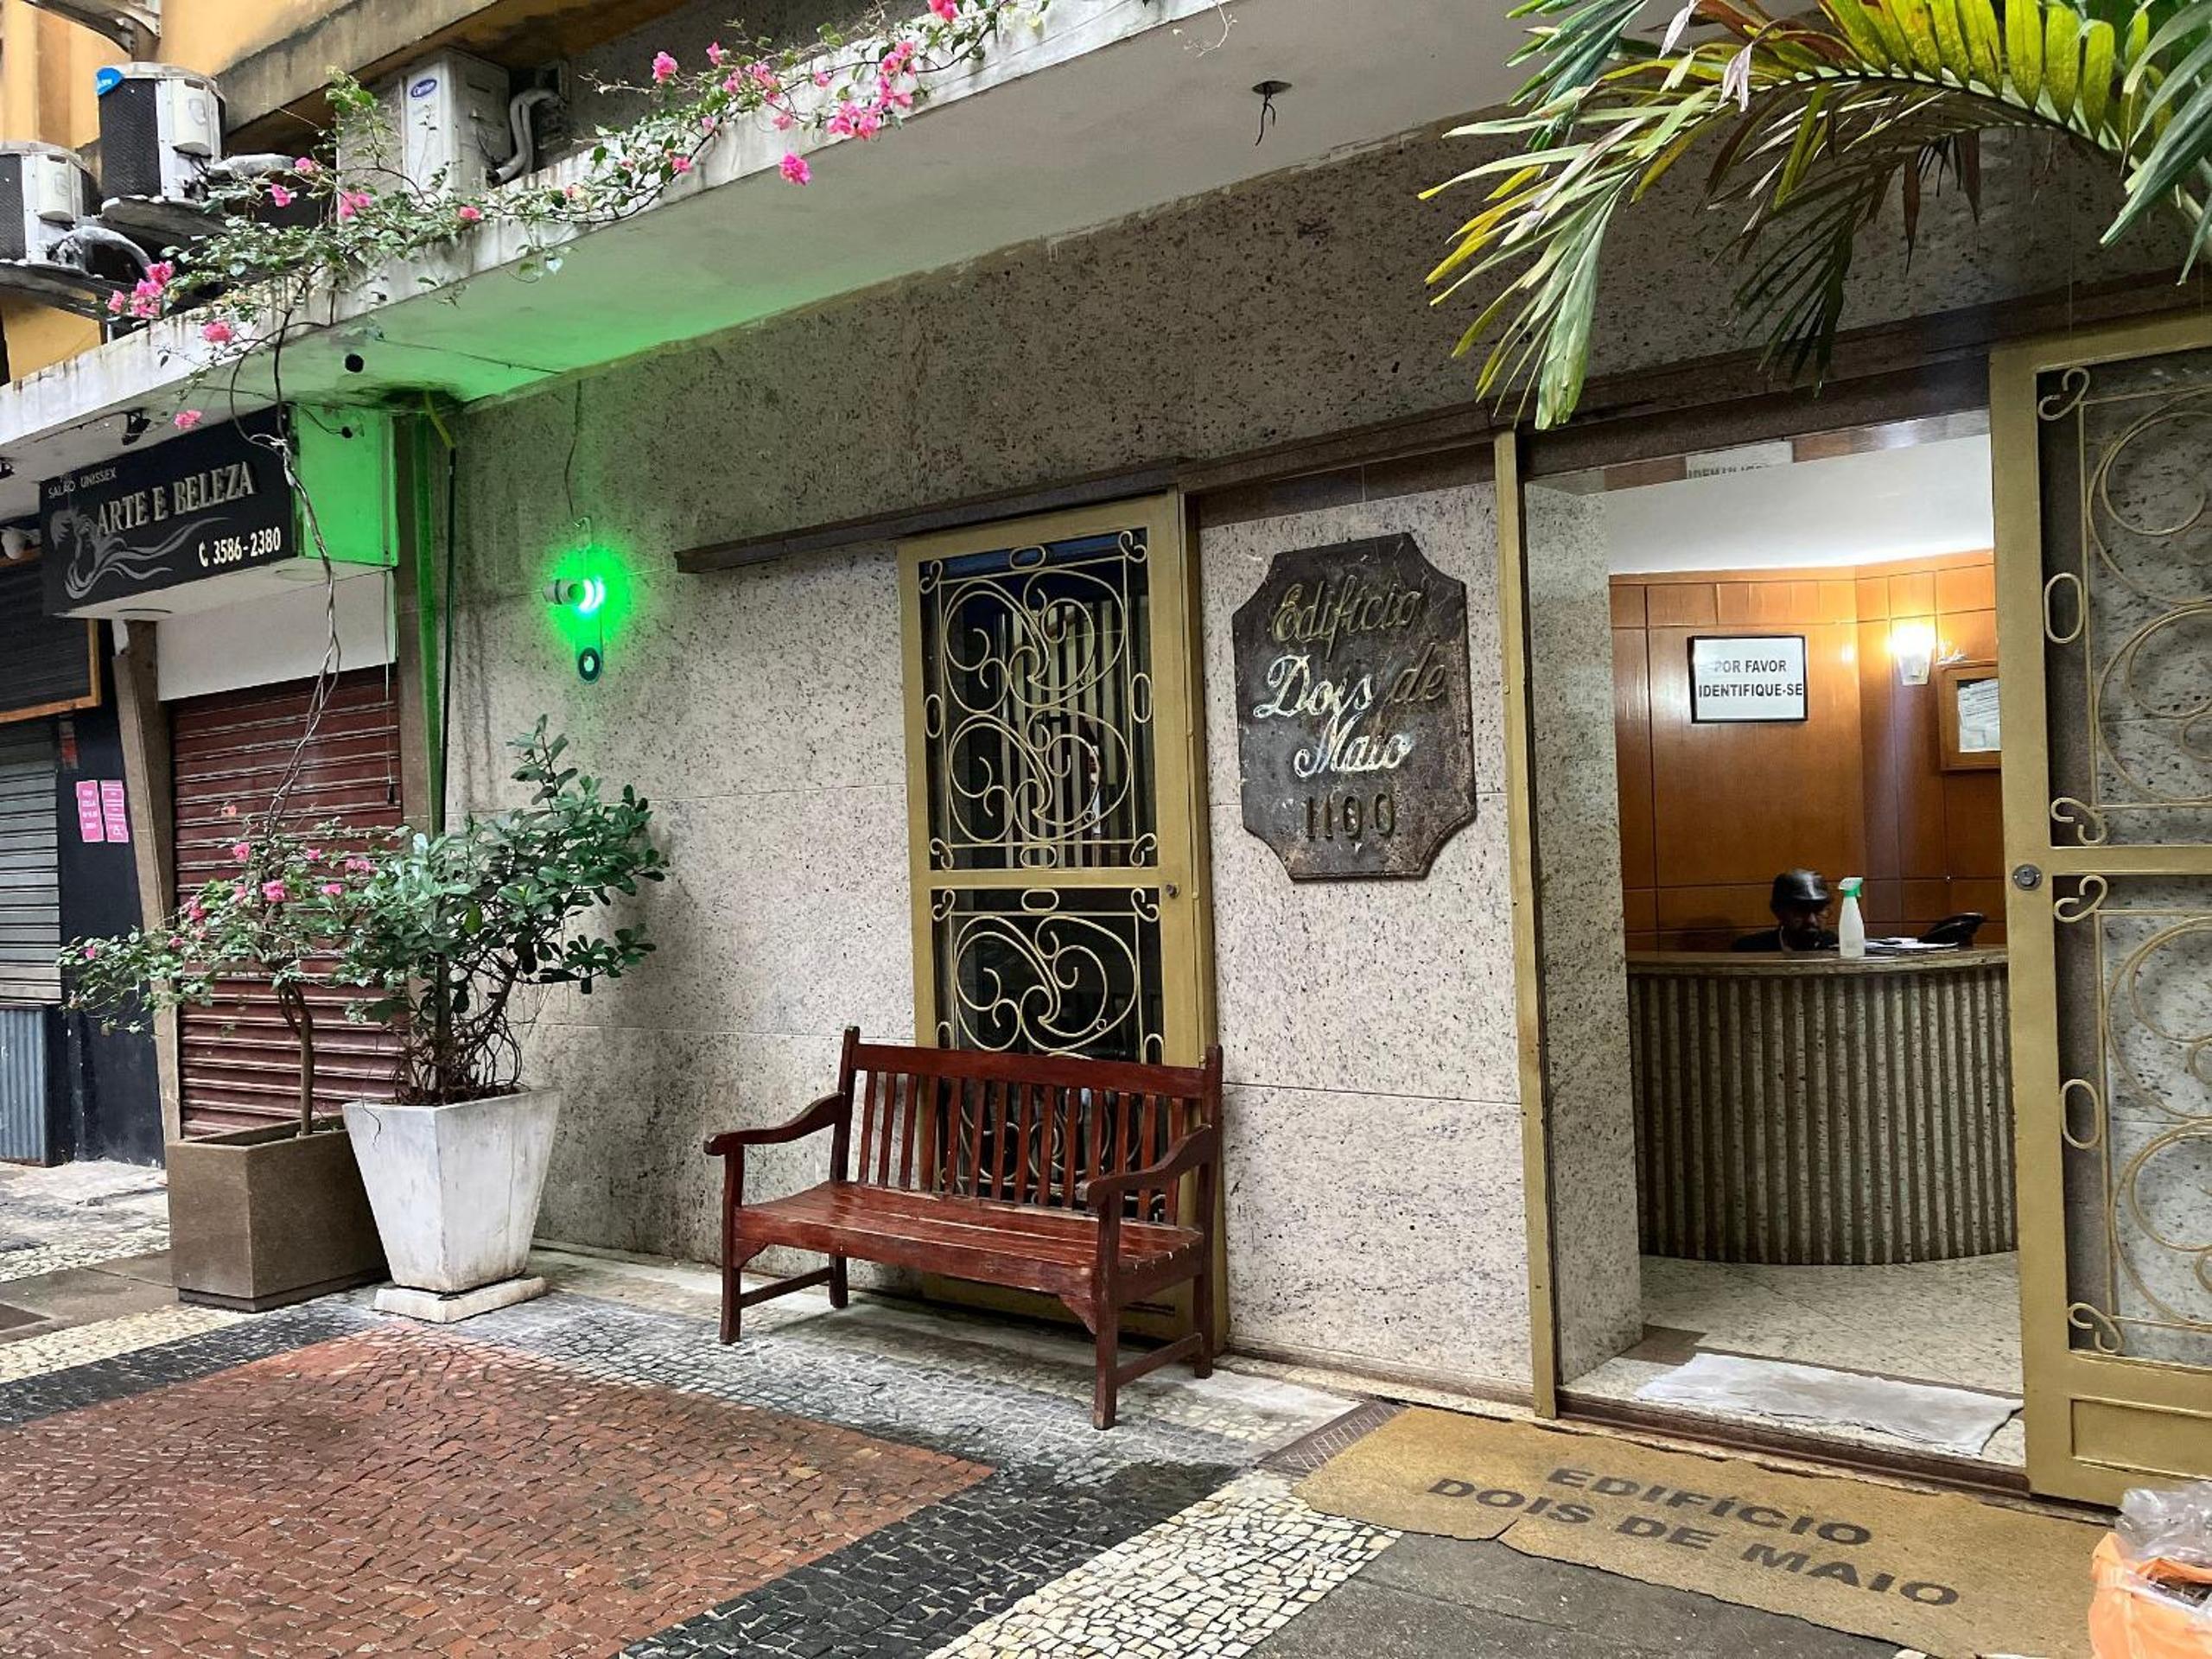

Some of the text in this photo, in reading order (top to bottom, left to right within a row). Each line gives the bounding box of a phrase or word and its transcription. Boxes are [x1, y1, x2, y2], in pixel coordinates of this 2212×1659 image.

[80, 467, 117, 487] UNISSEX
[97, 461, 254, 535] ARTE E BELEZA
[213, 526, 282, 564] 3586-2380
[1384, 643, 1445, 704] de
[1714, 659, 1787, 673] POR FAVOR
[1699, 683, 1803, 698] IDENTIFIQUE-SE
[1294, 712, 1414, 778] Maio
[1305, 792, 1395, 840] 1100
[1427, 1478, 1960, 1607] DOIS DE MAIO
